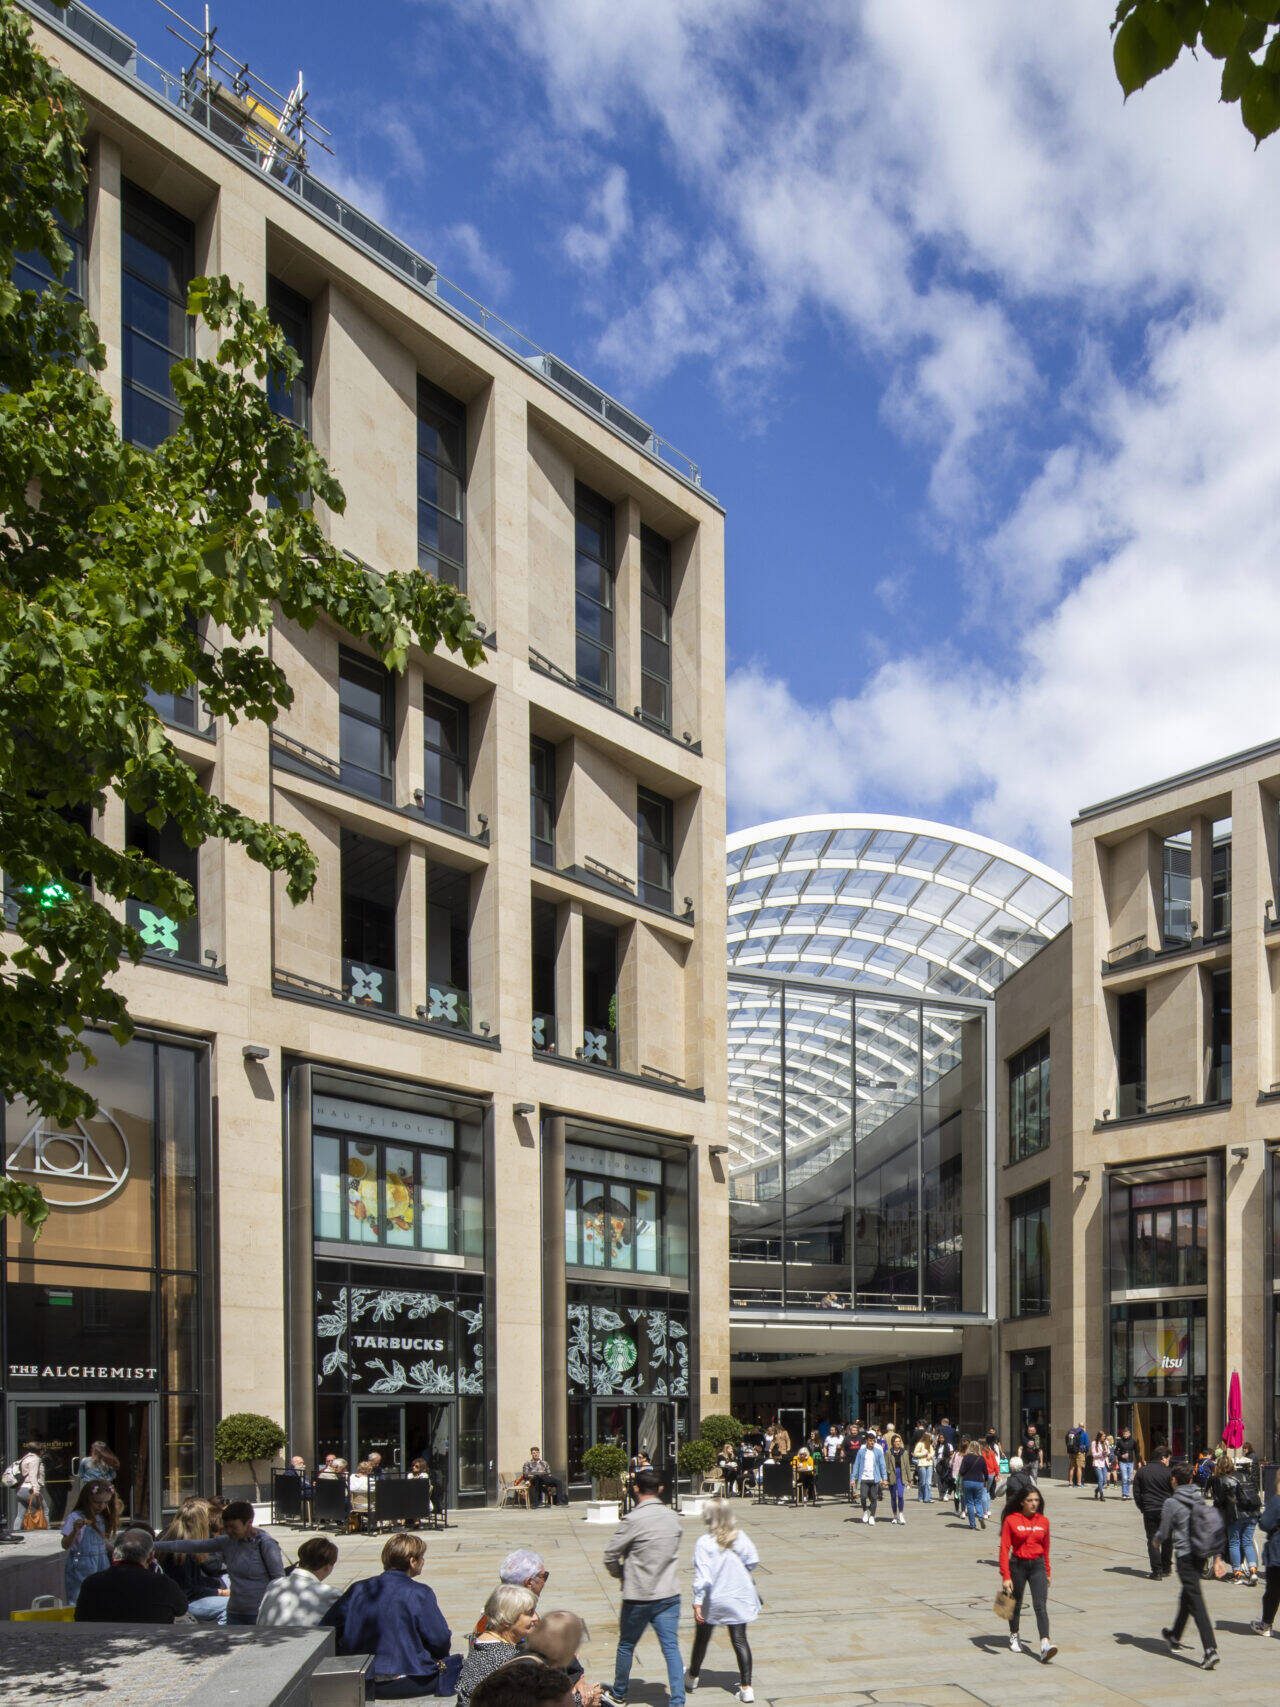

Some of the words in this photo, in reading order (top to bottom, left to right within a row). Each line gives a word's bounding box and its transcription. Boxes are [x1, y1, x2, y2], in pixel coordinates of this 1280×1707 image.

[570, 1153, 604, 1166] AUTE
[350, 1335, 444, 1351] TARBUCKS
[1161, 1355, 1184, 1368] itsu
[9, 1365, 38, 1376] THE
[42, 1366, 157, 1379] ALCHEMIST
